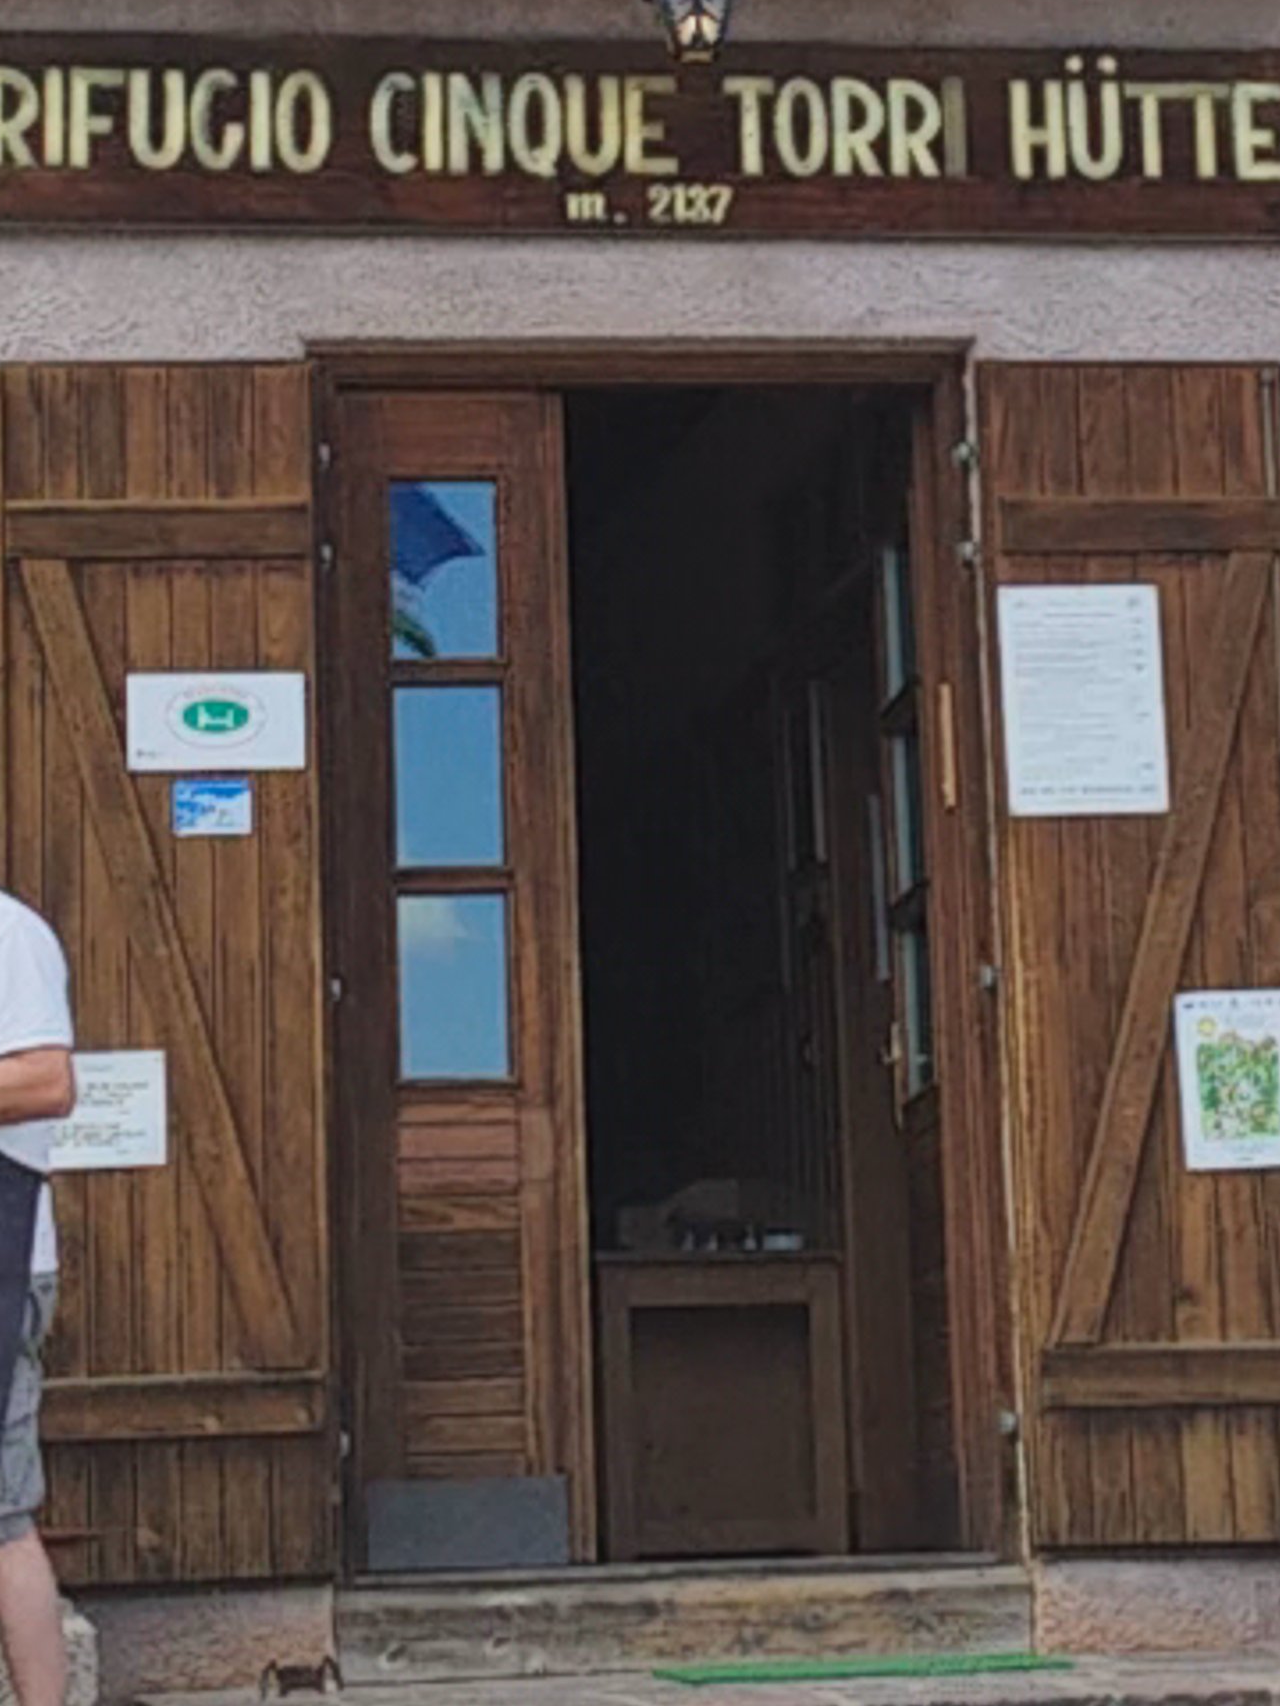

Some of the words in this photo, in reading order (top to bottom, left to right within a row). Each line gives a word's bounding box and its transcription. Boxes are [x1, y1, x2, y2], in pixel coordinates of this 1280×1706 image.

[369, 70, 680, 179] CINQUE
[721, 75, 968, 180] TORRI
[565, 191, 629, 225] m.
[646, 183, 734, 224] 2137
